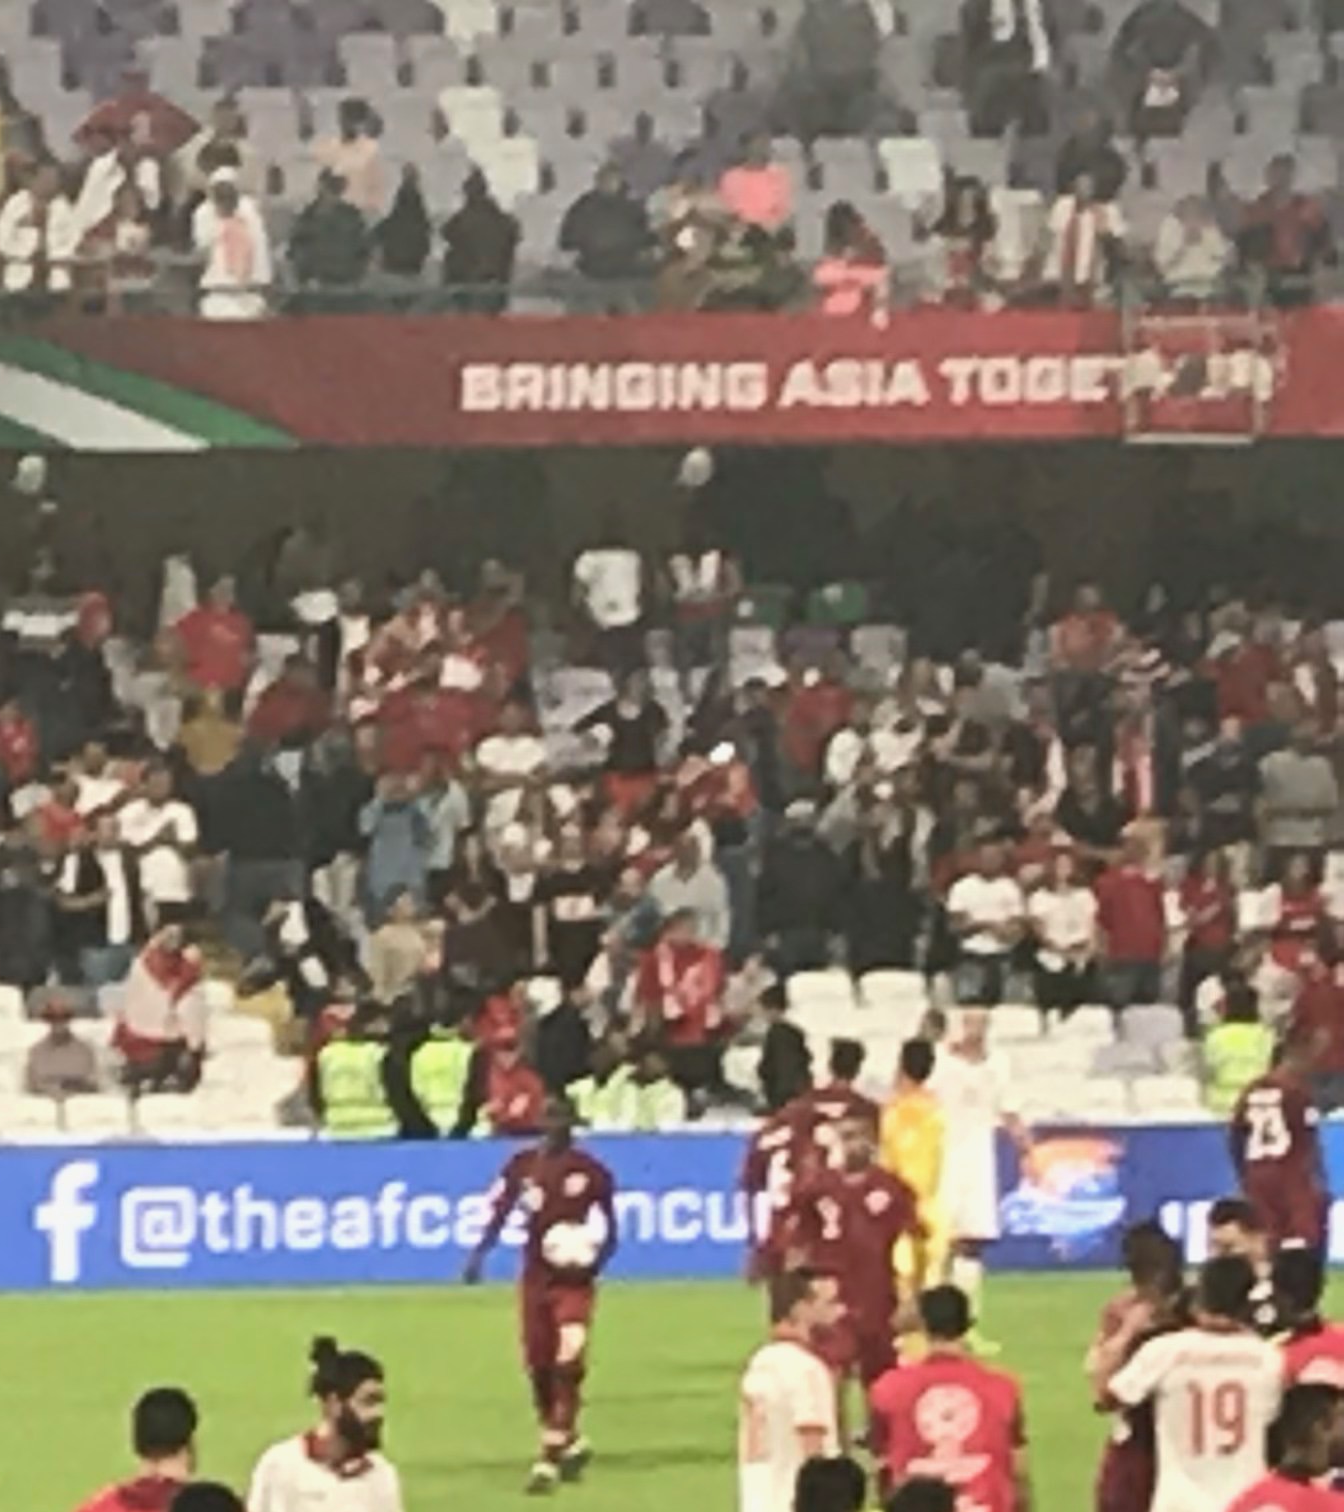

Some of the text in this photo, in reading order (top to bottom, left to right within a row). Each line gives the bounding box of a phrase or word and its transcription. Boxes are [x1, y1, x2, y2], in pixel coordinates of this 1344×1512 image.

[461, 361, 767, 411] BRINGING
[777, 358, 930, 407] ASIA
[1185, 1380, 1246, 1456] 19
